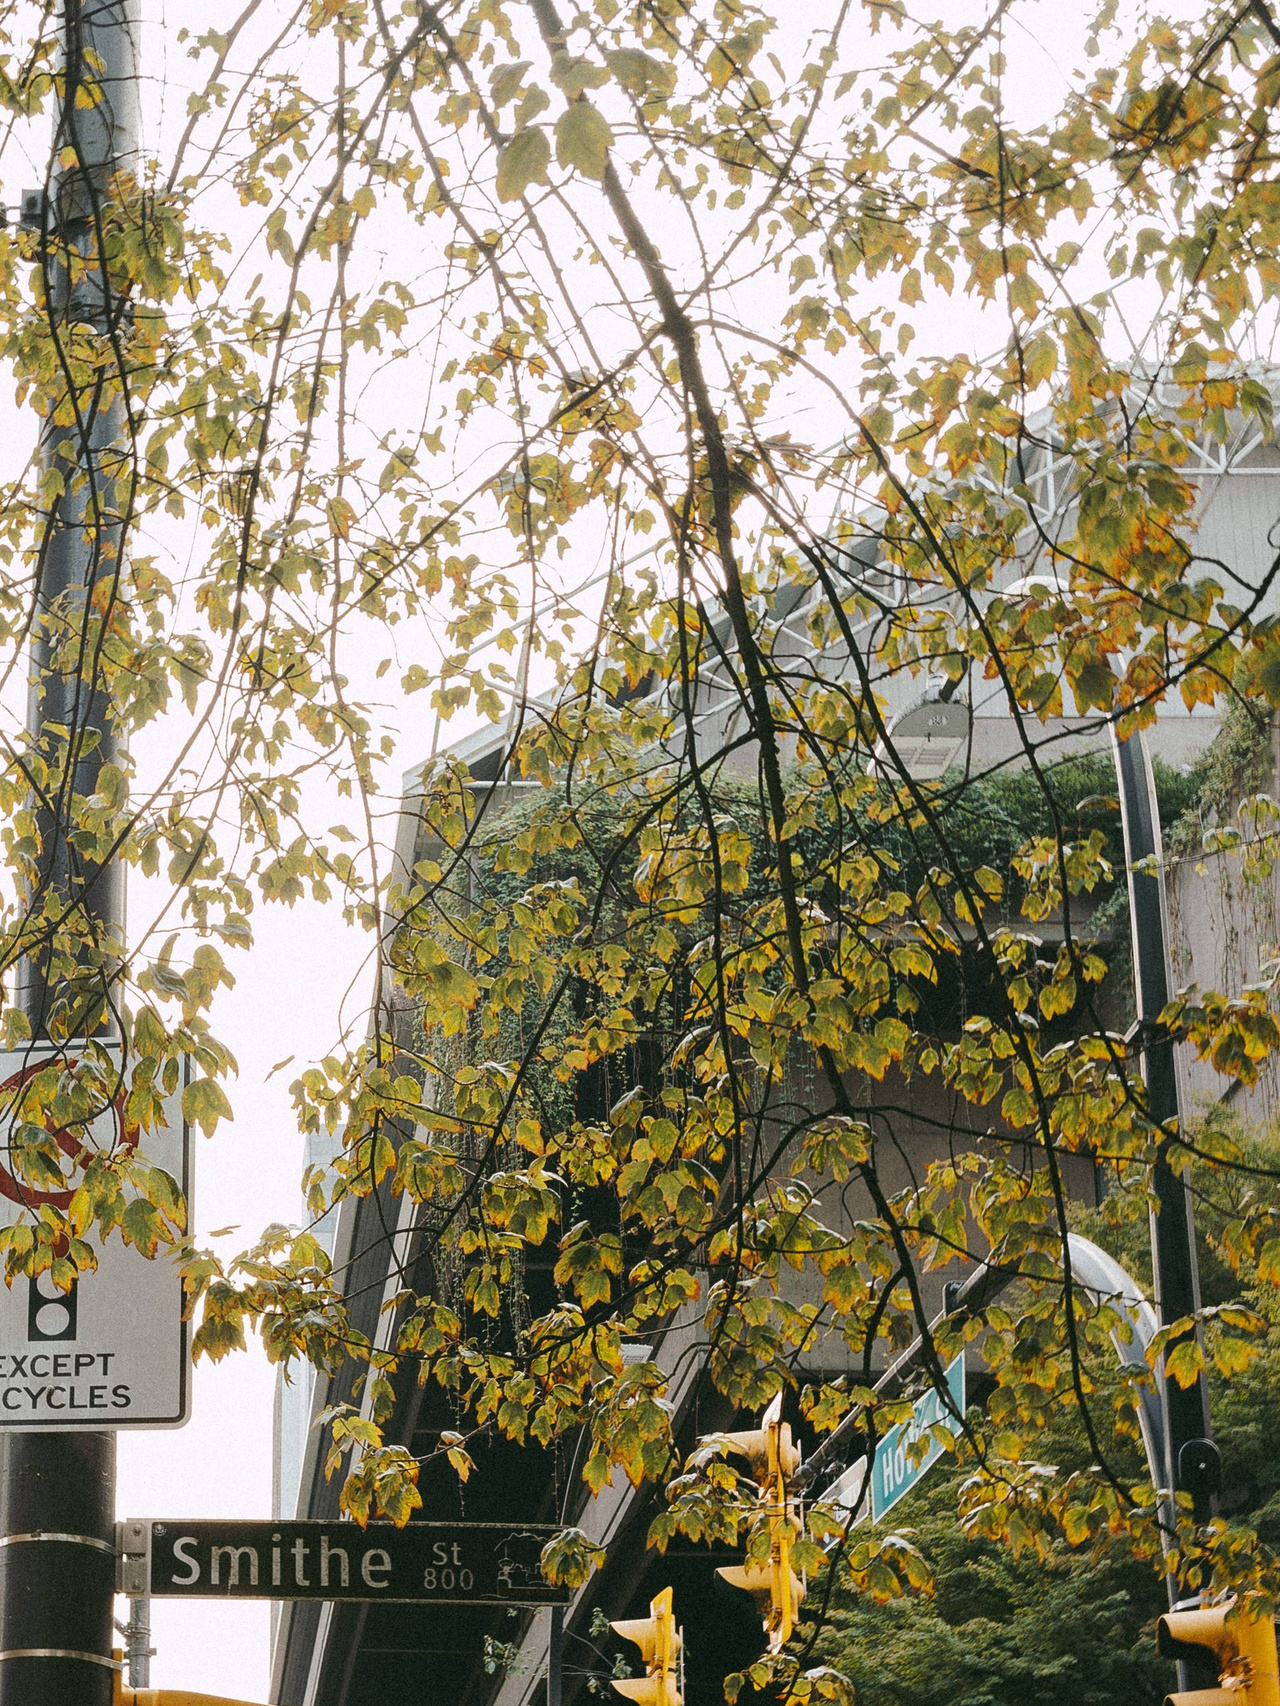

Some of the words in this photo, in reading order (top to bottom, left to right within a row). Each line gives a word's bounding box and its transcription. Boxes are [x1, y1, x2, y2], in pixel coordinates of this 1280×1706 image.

[171, 1533, 393, 1588] Smithe
[432, 1542, 462, 1566] St
[423, 1568, 474, 1590] 800
